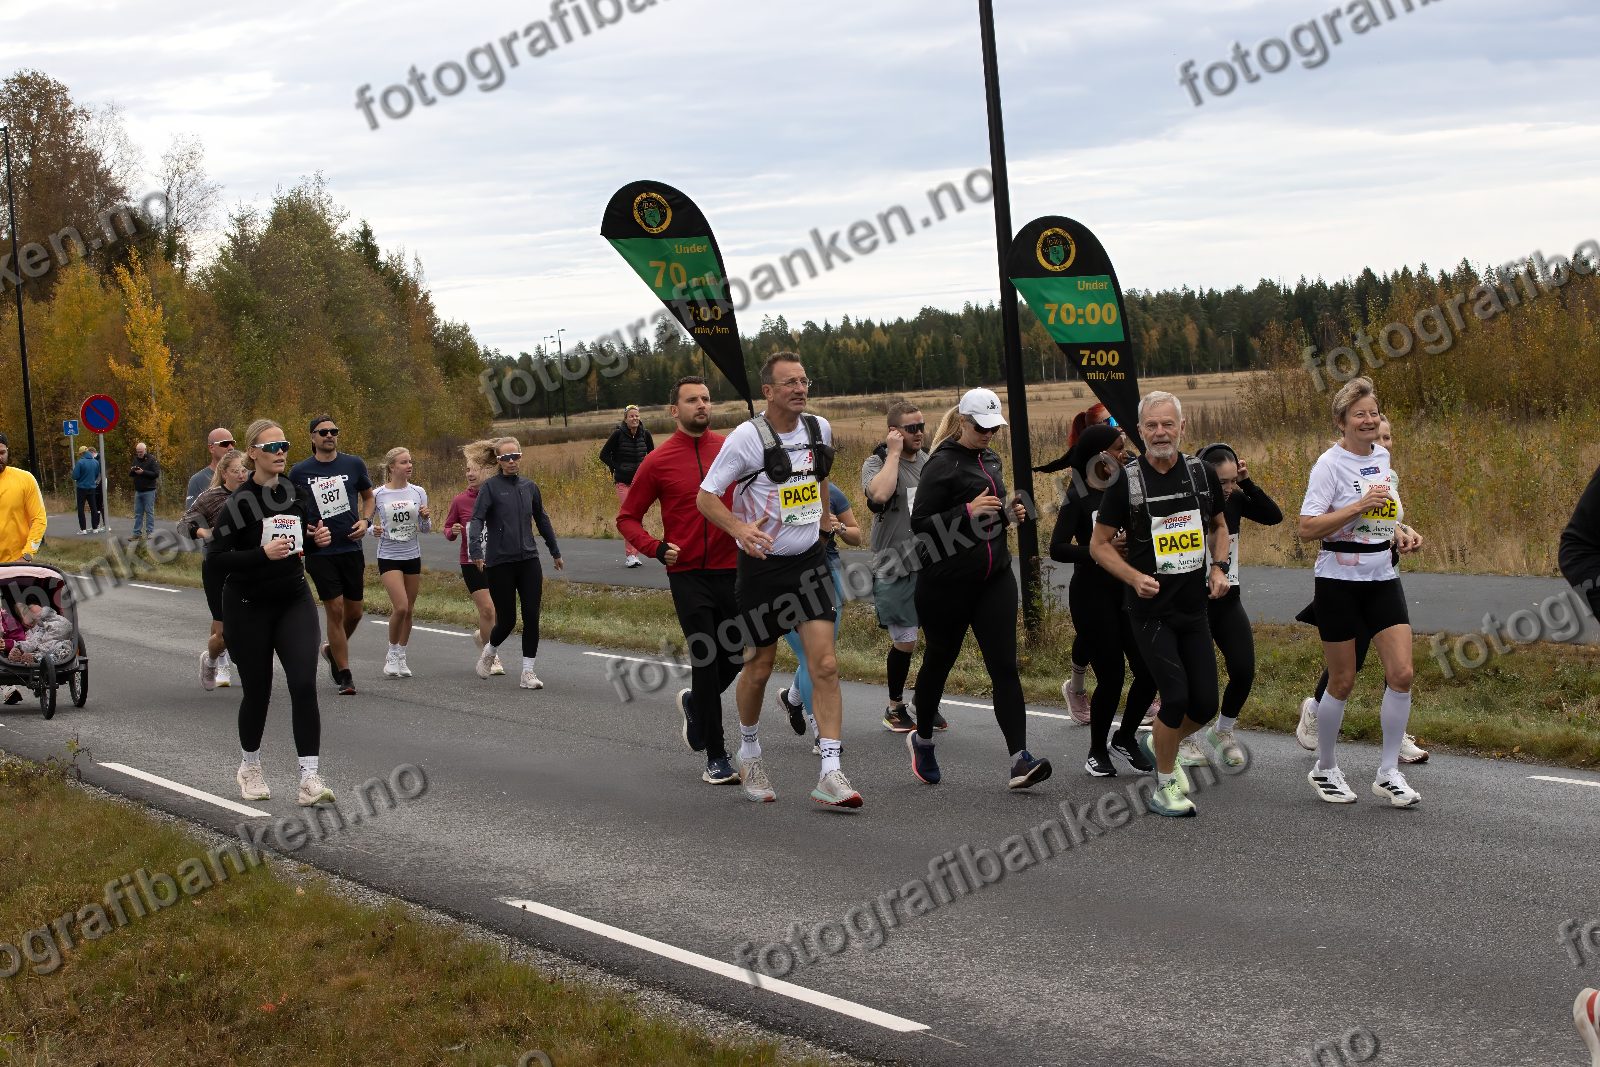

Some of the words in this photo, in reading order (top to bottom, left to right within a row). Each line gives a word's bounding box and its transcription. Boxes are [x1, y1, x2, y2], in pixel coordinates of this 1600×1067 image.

[675, 243, 707, 254] Under
[649, 260, 688, 288] 70
[1077, 280, 1108, 291] Under
[688, 305, 722, 321] 7:00
[1044, 302, 1117, 325] 70:00
[1079, 349, 1120, 367] 7:00
[1086, 371, 1125, 380] min/km
[321, 489, 341, 505] 387
[783, 485, 817, 506] PACE
[392, 511, 411, 523] 403
[1162, 514, 1192, 525] NORGES
[1158, 532, 1200, 553] PACE
